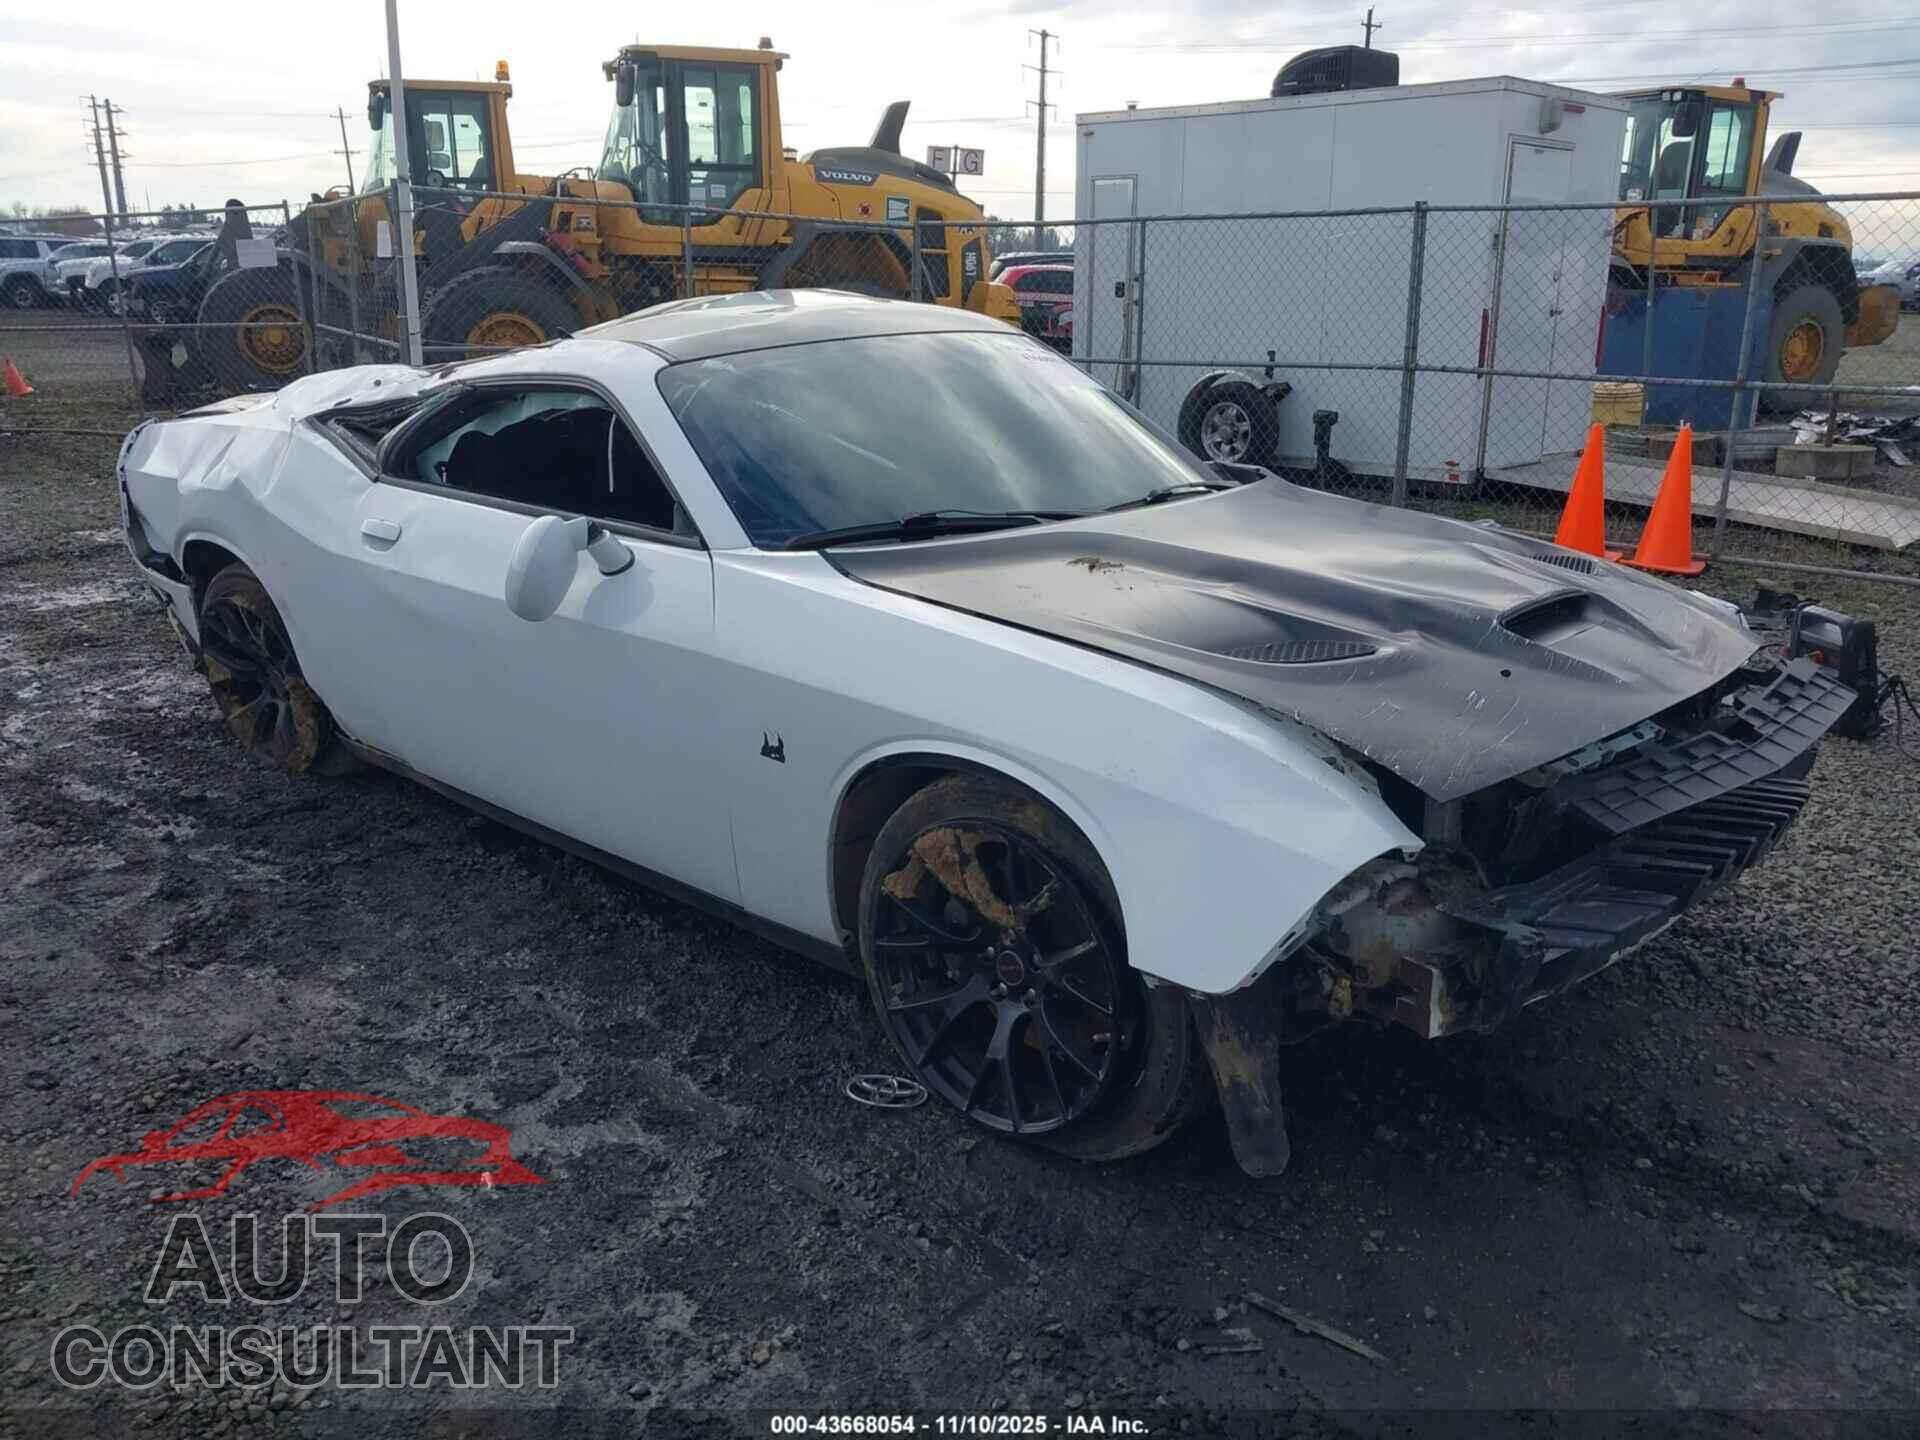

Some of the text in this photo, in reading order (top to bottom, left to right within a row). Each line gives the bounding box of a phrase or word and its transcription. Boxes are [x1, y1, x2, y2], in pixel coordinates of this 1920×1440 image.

[963, 151, 978, 173] G
[820, 170, 872, 183] VOLVO
[965, 251, 977, 276] L90H
